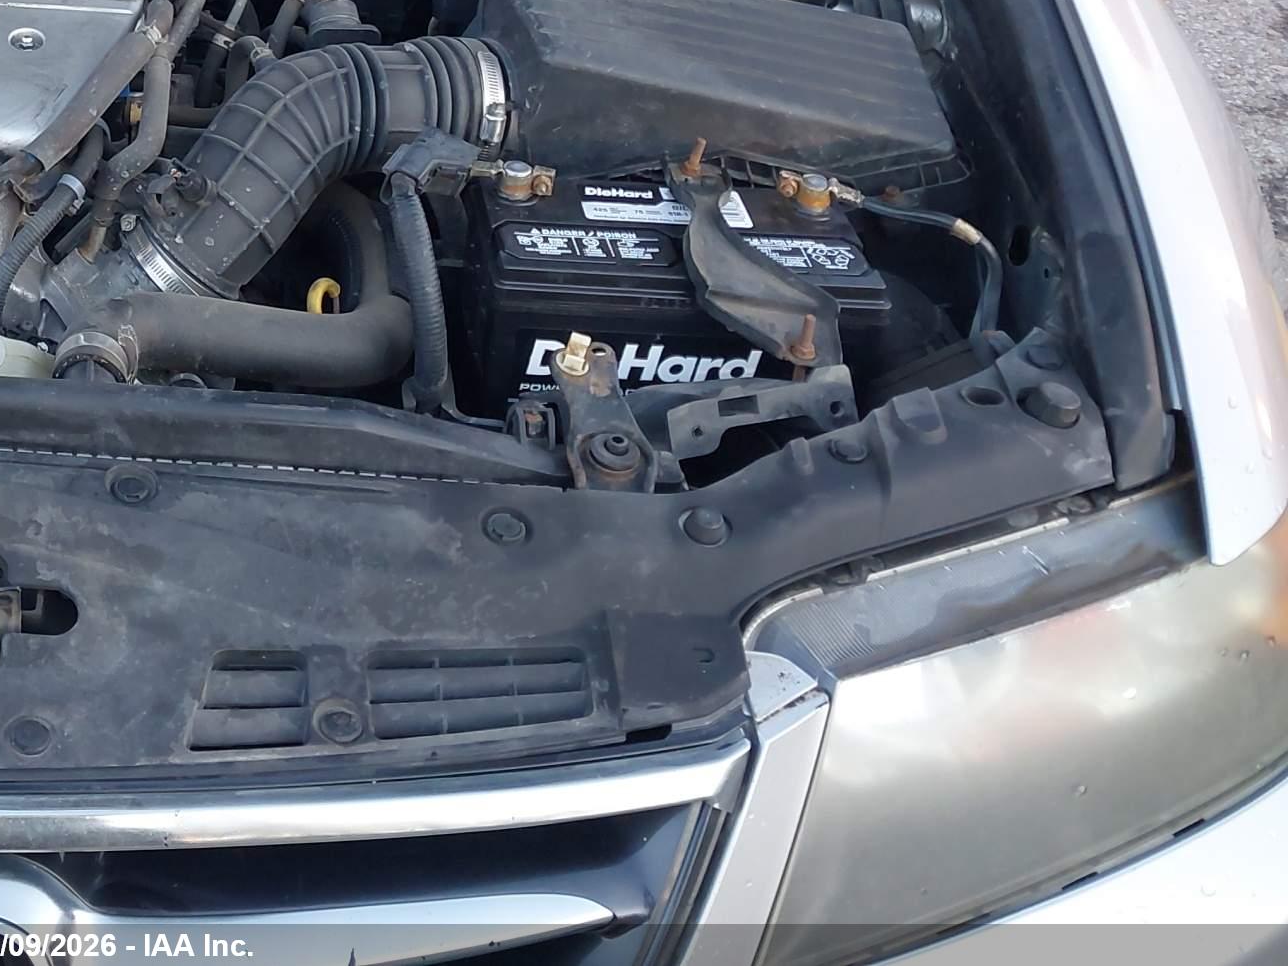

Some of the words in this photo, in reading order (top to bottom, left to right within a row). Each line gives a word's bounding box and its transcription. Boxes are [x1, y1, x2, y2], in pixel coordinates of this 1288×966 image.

[584, 186, 654, 199] DieHard
[541, 228, 587, 237] DANGER
[596, 230, 637, 240] POISON
[526, 339, 764, 383] DHard
